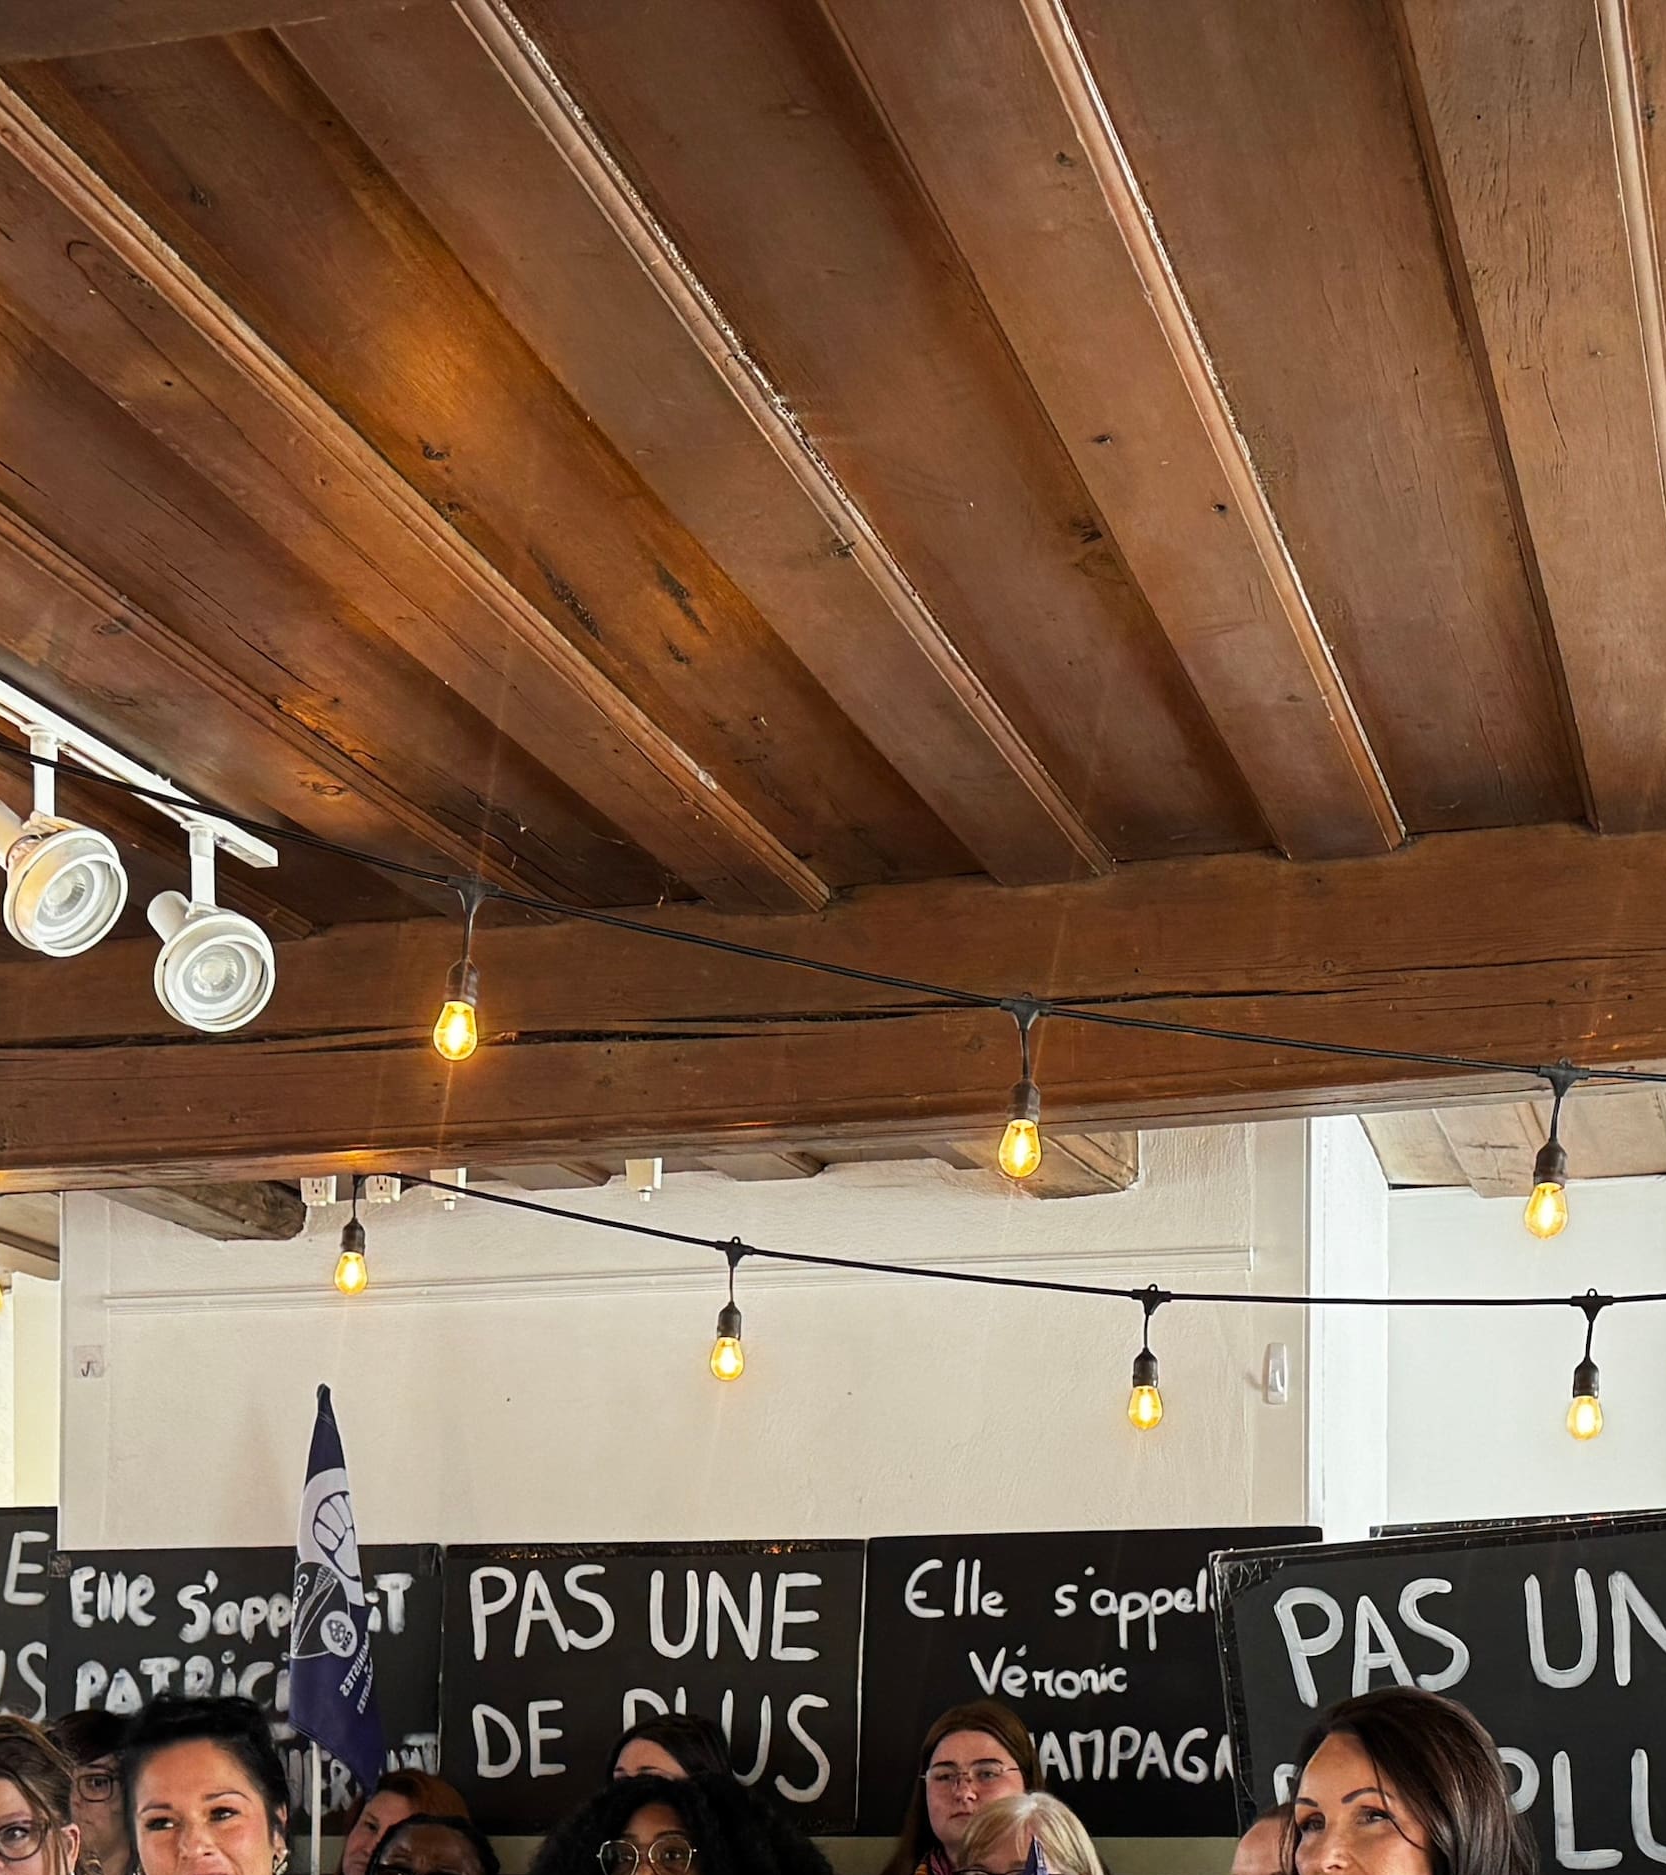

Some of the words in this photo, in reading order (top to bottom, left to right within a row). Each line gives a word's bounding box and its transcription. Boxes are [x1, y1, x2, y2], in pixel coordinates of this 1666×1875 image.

[70, 1565, 156, 1628] Elle
[469, 1564, 615, 1661] PAS
[649, 1569, 823, 1663] UNE
[904, 1558, 1008, 1619] Elle
[968, 1645, 1128, 1700] Véronic
[1273, 1577, 1470, 1708] PAS
[472, 1699, 567, 1779] DE
